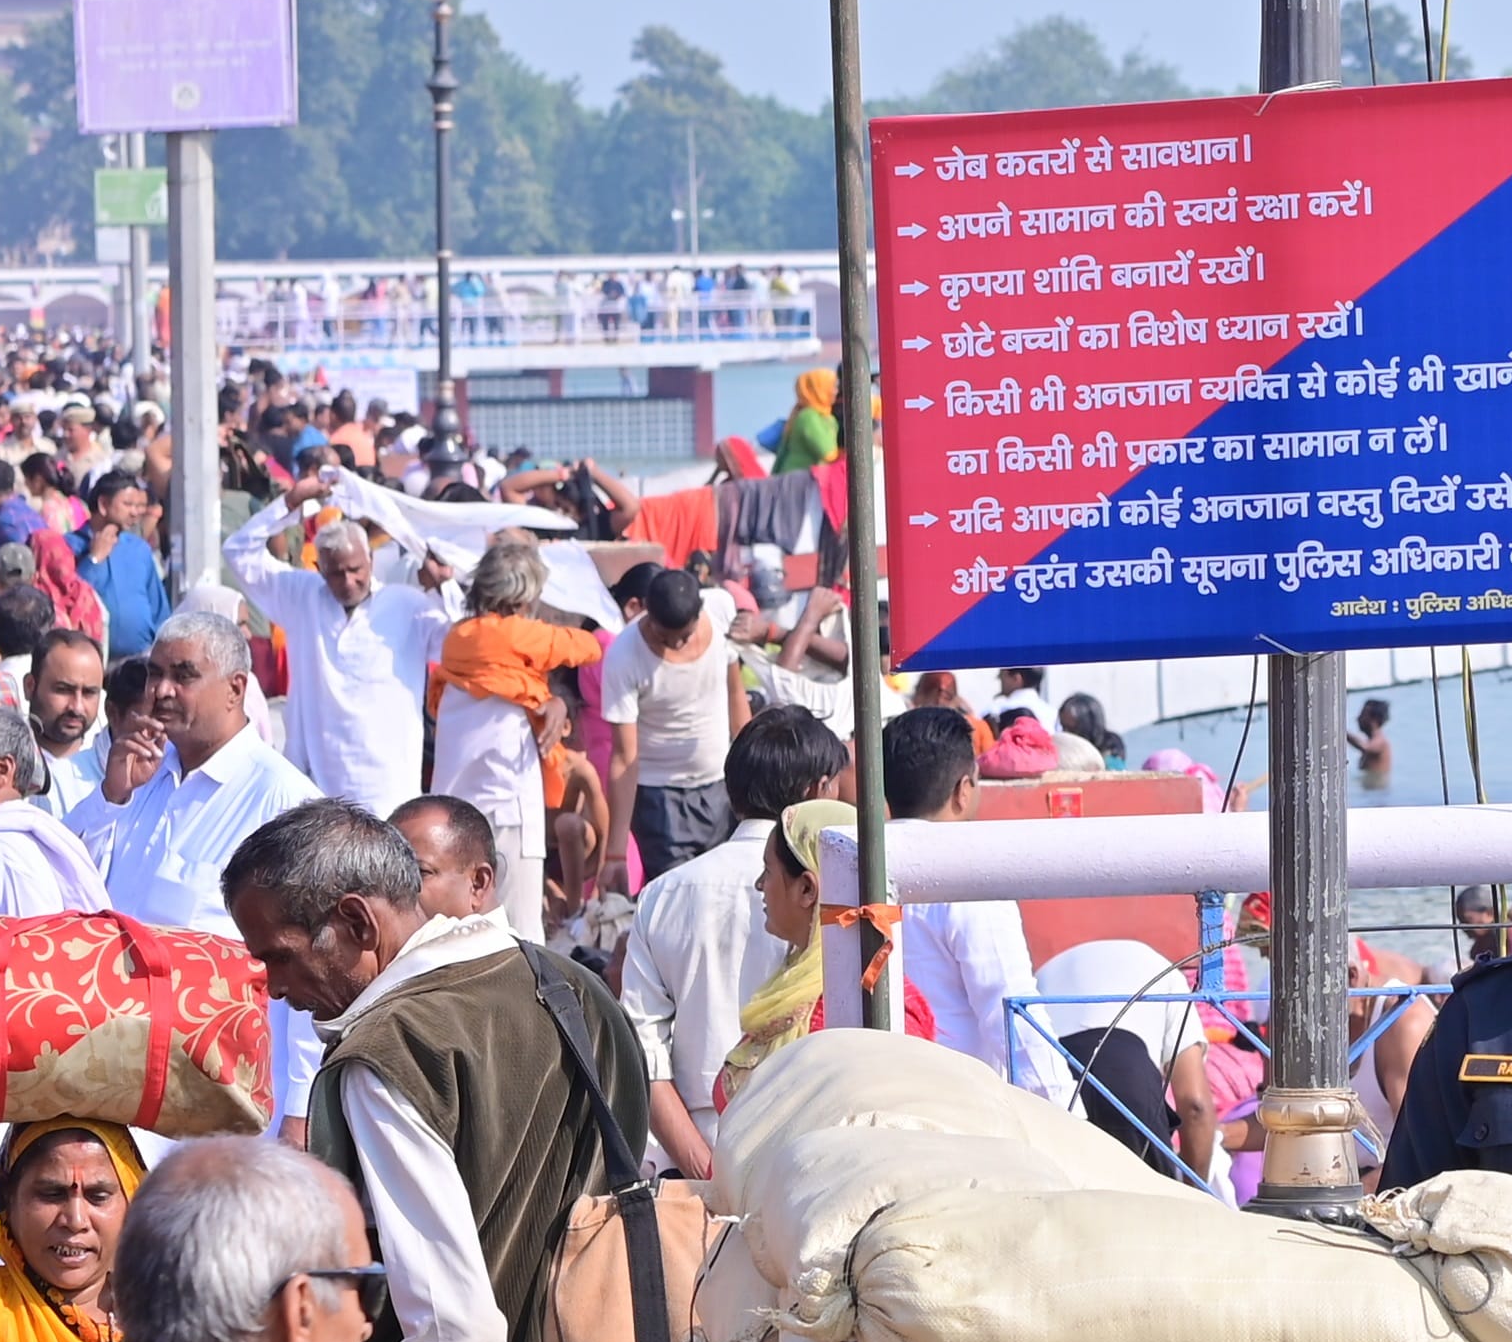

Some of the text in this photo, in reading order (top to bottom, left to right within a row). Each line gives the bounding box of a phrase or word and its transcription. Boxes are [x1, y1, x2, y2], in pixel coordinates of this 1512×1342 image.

[933, 134, 1251, 181] जेब कतरों से सावधान।
[937, 179, 1372, 241] अपने सामान की स्वयं रक्षा करें।
[939, 245, 1264, 311] कृपया शांति बनायें रखें।
[941, 300, 1363, 359] छोटे बच्चों का विशेष ध्यान रखें।
[943, 377, 1023, 417] किसी
[1030, 374, 1067, 412] भी
[1073, 378, 1193, 411] अनजान
[1198, 364, 1291, 402] व्यक्ति
[1297, 361, 1328, 399] से
[1333, 356, 1401, 399] कोई
[1408, 354, 1446, 392] भी
[946, 415, 1448, 476] का किसी भी प्रकार का सामान न लें।
[948, 496, 1005, 534] यदि
[1011, 491, 1112, 532] आपको
[1118, 486, 1183, 529] कोई
[1190, 492, 1311, 524] अनजान
[1316, 488, 1384, 529] वस्तु
[1388, 474, 1462, 514] दिखें
[951, 555, 1009, 595] और
[1012, 553, 1078, 603] तुरंत
[1084, 547, 1175, 588] उसकी
[1180, 554, 1268, 595] सूचना
[1273, 540, 1363, 592] पुलिस
[1369, 532, 1503, 576] अधिकारी
[1330, 596, 1388, 617] आदेश
[1406, 590, 1461, 620] पुलिस
